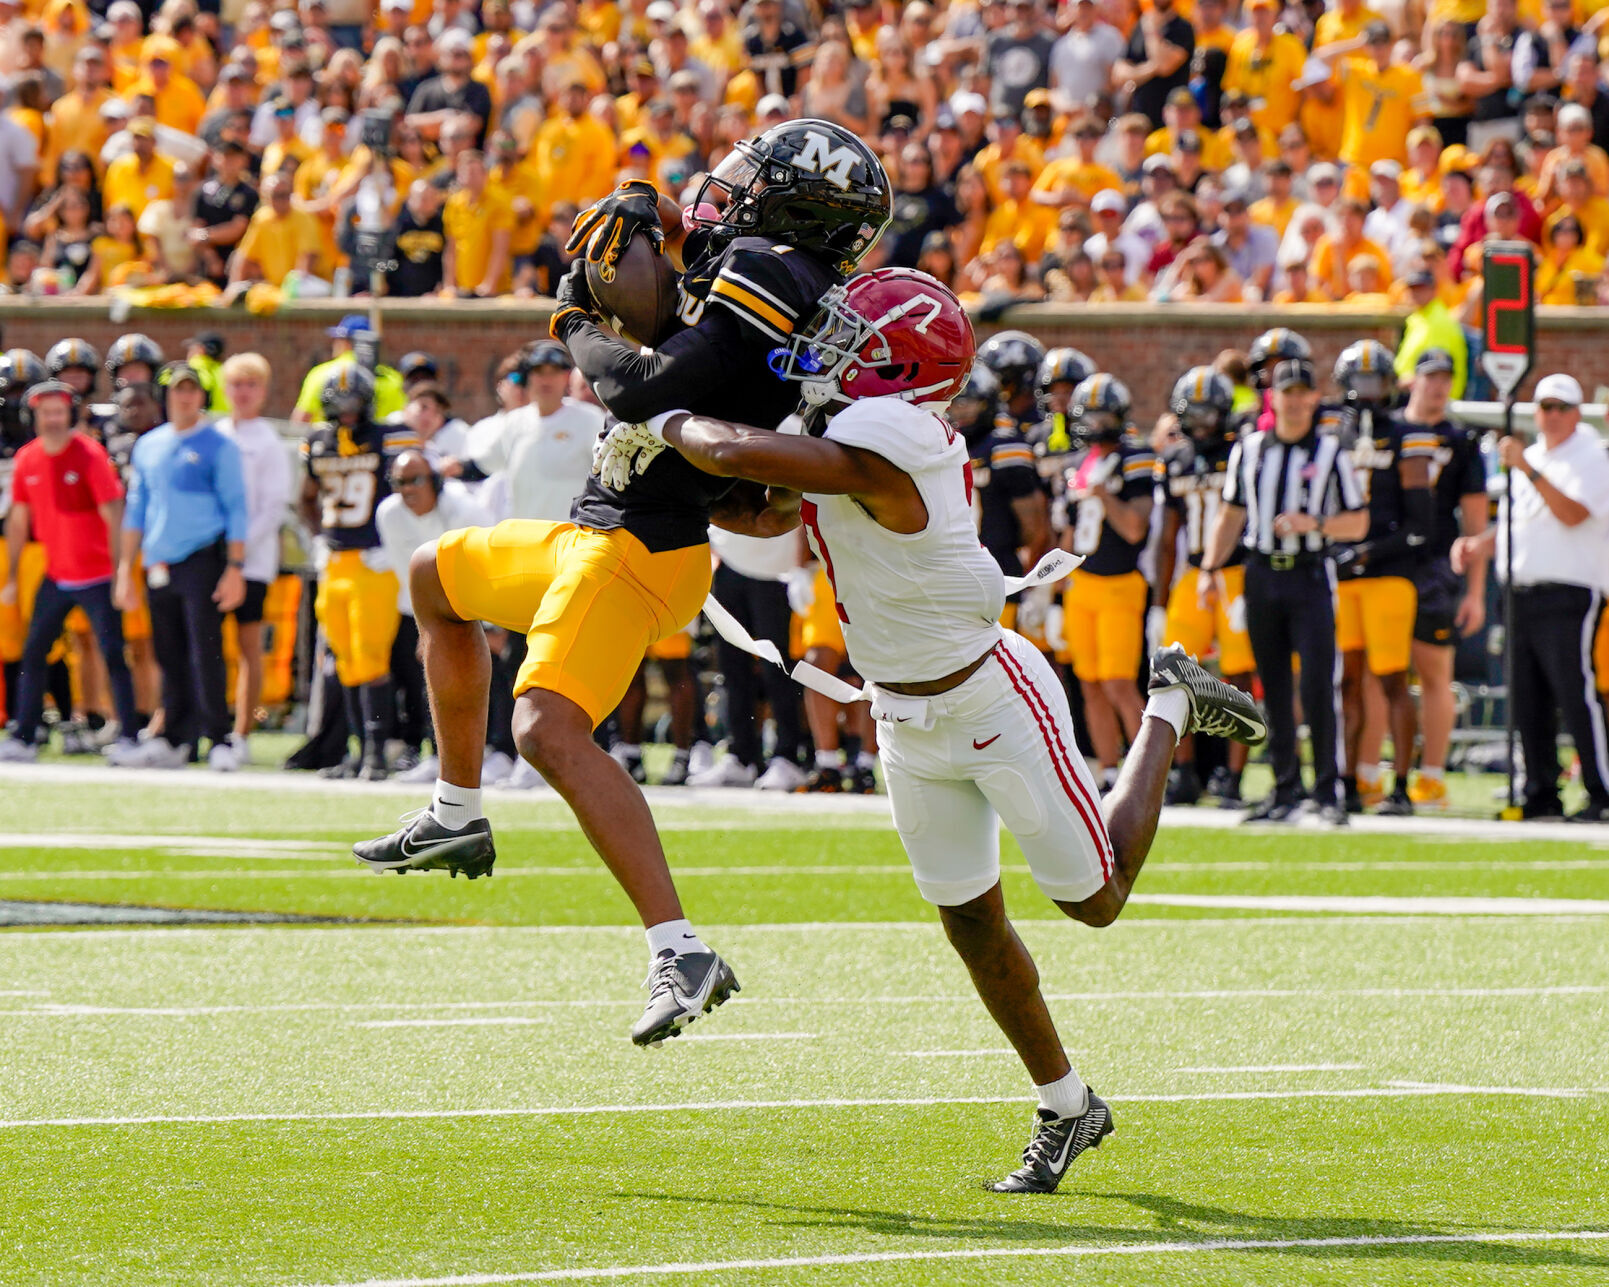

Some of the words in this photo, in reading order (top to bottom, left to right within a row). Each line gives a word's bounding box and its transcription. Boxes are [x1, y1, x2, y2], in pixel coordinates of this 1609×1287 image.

[790, 130, 862, 192] M
[897, 293, 942, 334] 7
[1488, 256, 1529, 354] 2
[319, 470, 377, 528] 29
